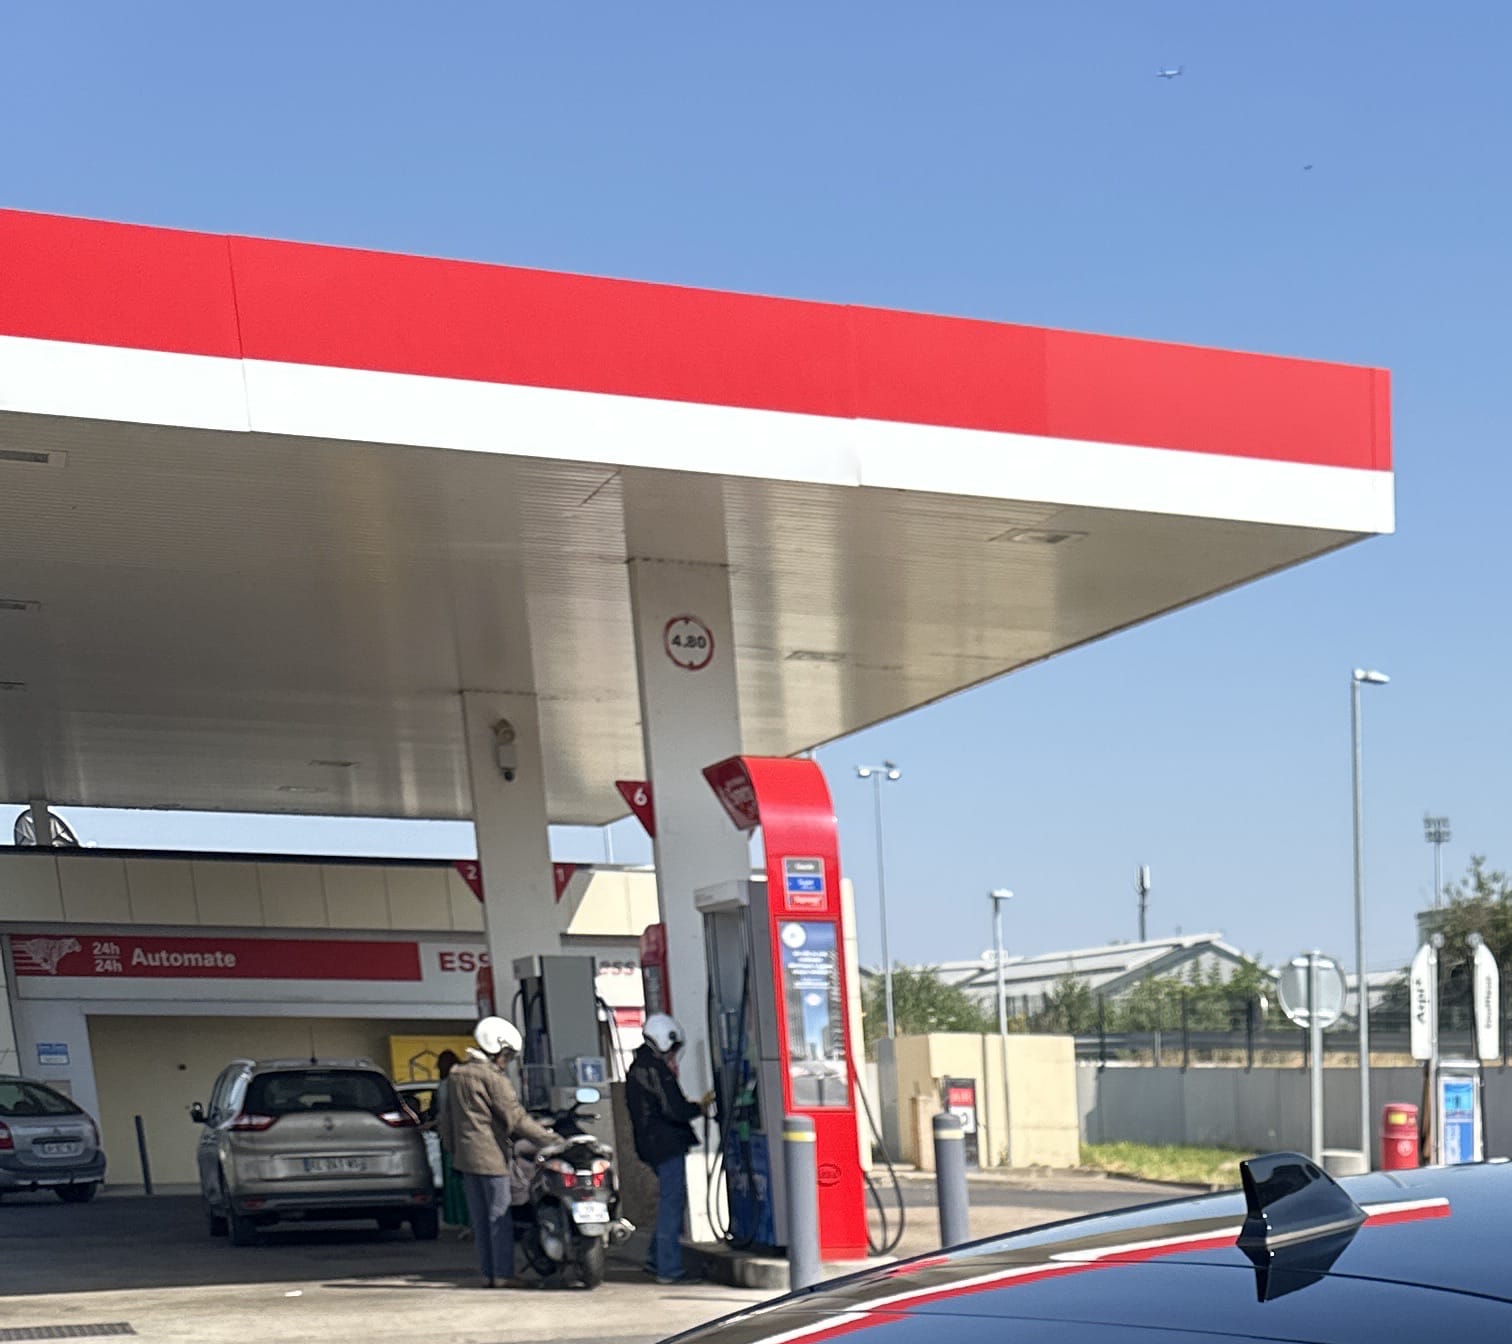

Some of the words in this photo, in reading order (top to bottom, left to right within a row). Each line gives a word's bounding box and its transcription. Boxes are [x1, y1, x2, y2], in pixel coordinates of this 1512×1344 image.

[634, 788, 647, 806] 6
[465, 865, 478, 880] 2
[93, 942, 120, 955] 24h
[131, 948, 237, 968] Automate
[95, 960, 123, 972] 24h
